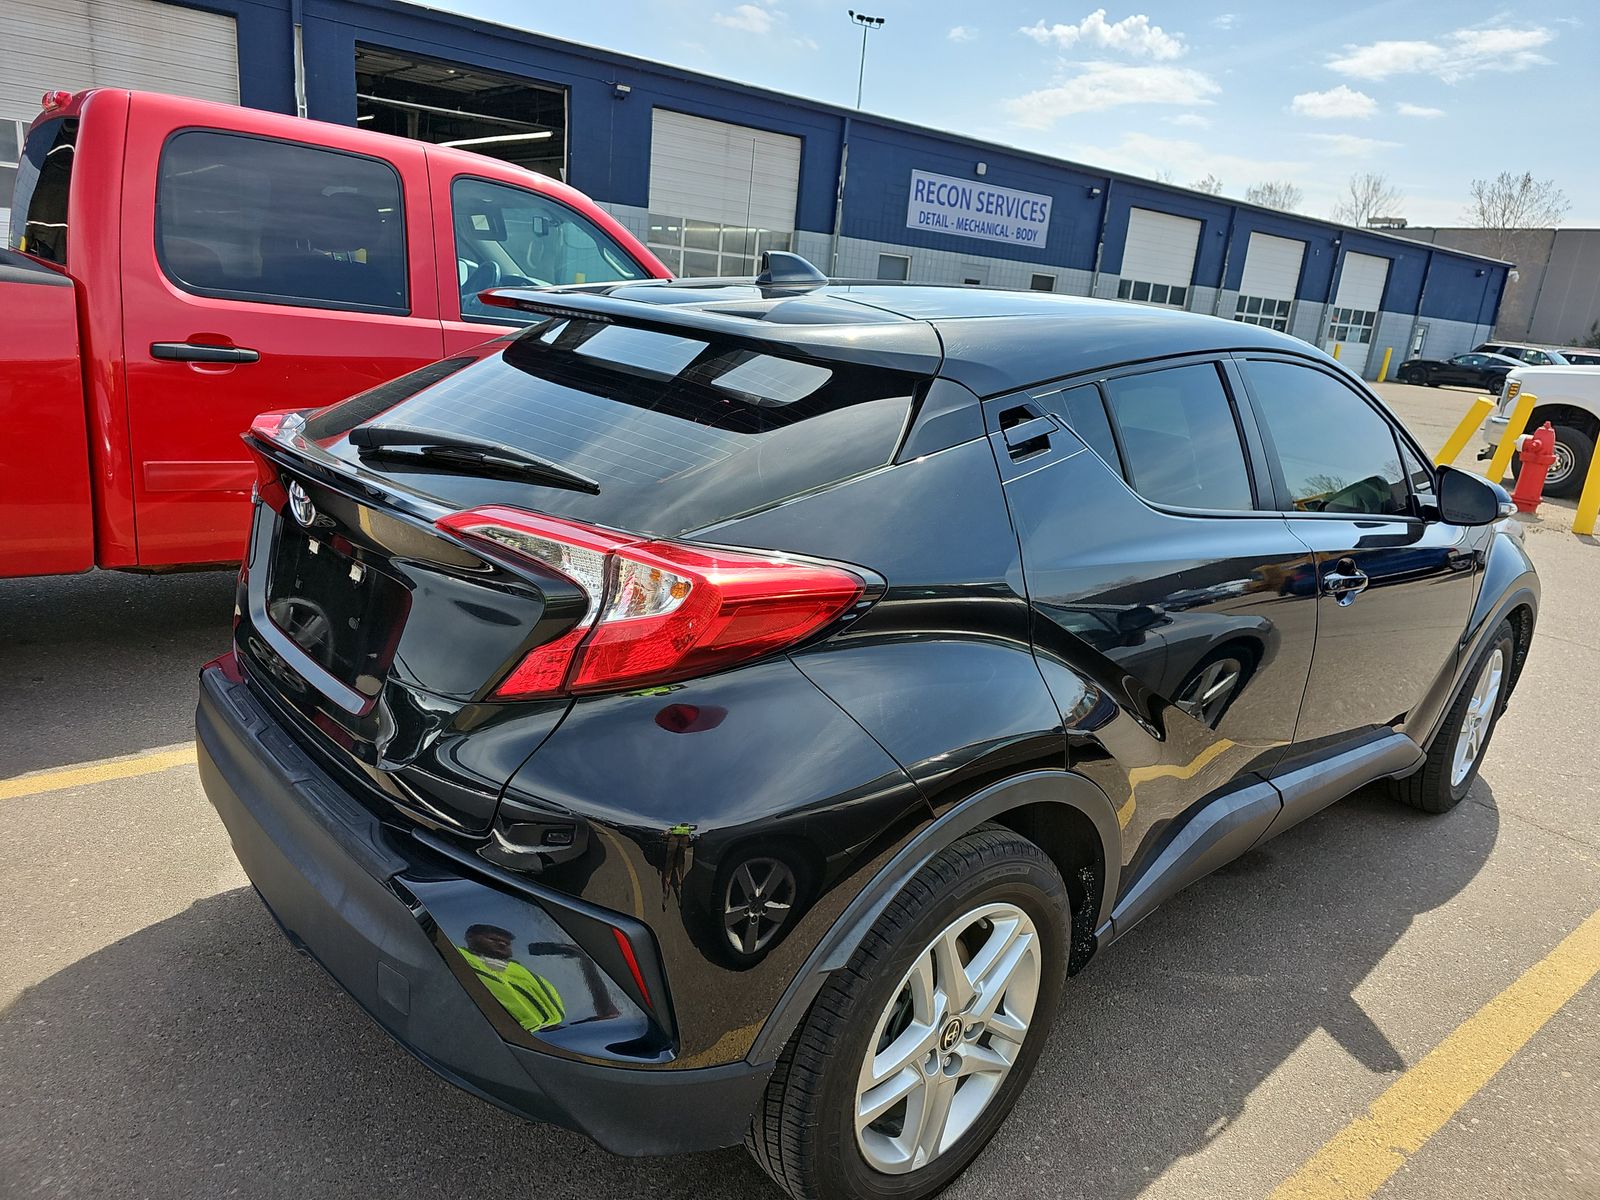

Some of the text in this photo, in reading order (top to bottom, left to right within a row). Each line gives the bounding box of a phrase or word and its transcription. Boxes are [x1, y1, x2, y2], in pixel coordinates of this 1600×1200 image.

[914, 178, 1047, 223] RECON SERVICES
[918, 210, 949, 228] DETAIL
[955, 216, 1009, 238] MECHANICAL
[1015, 227, 1039, 242] BODY
